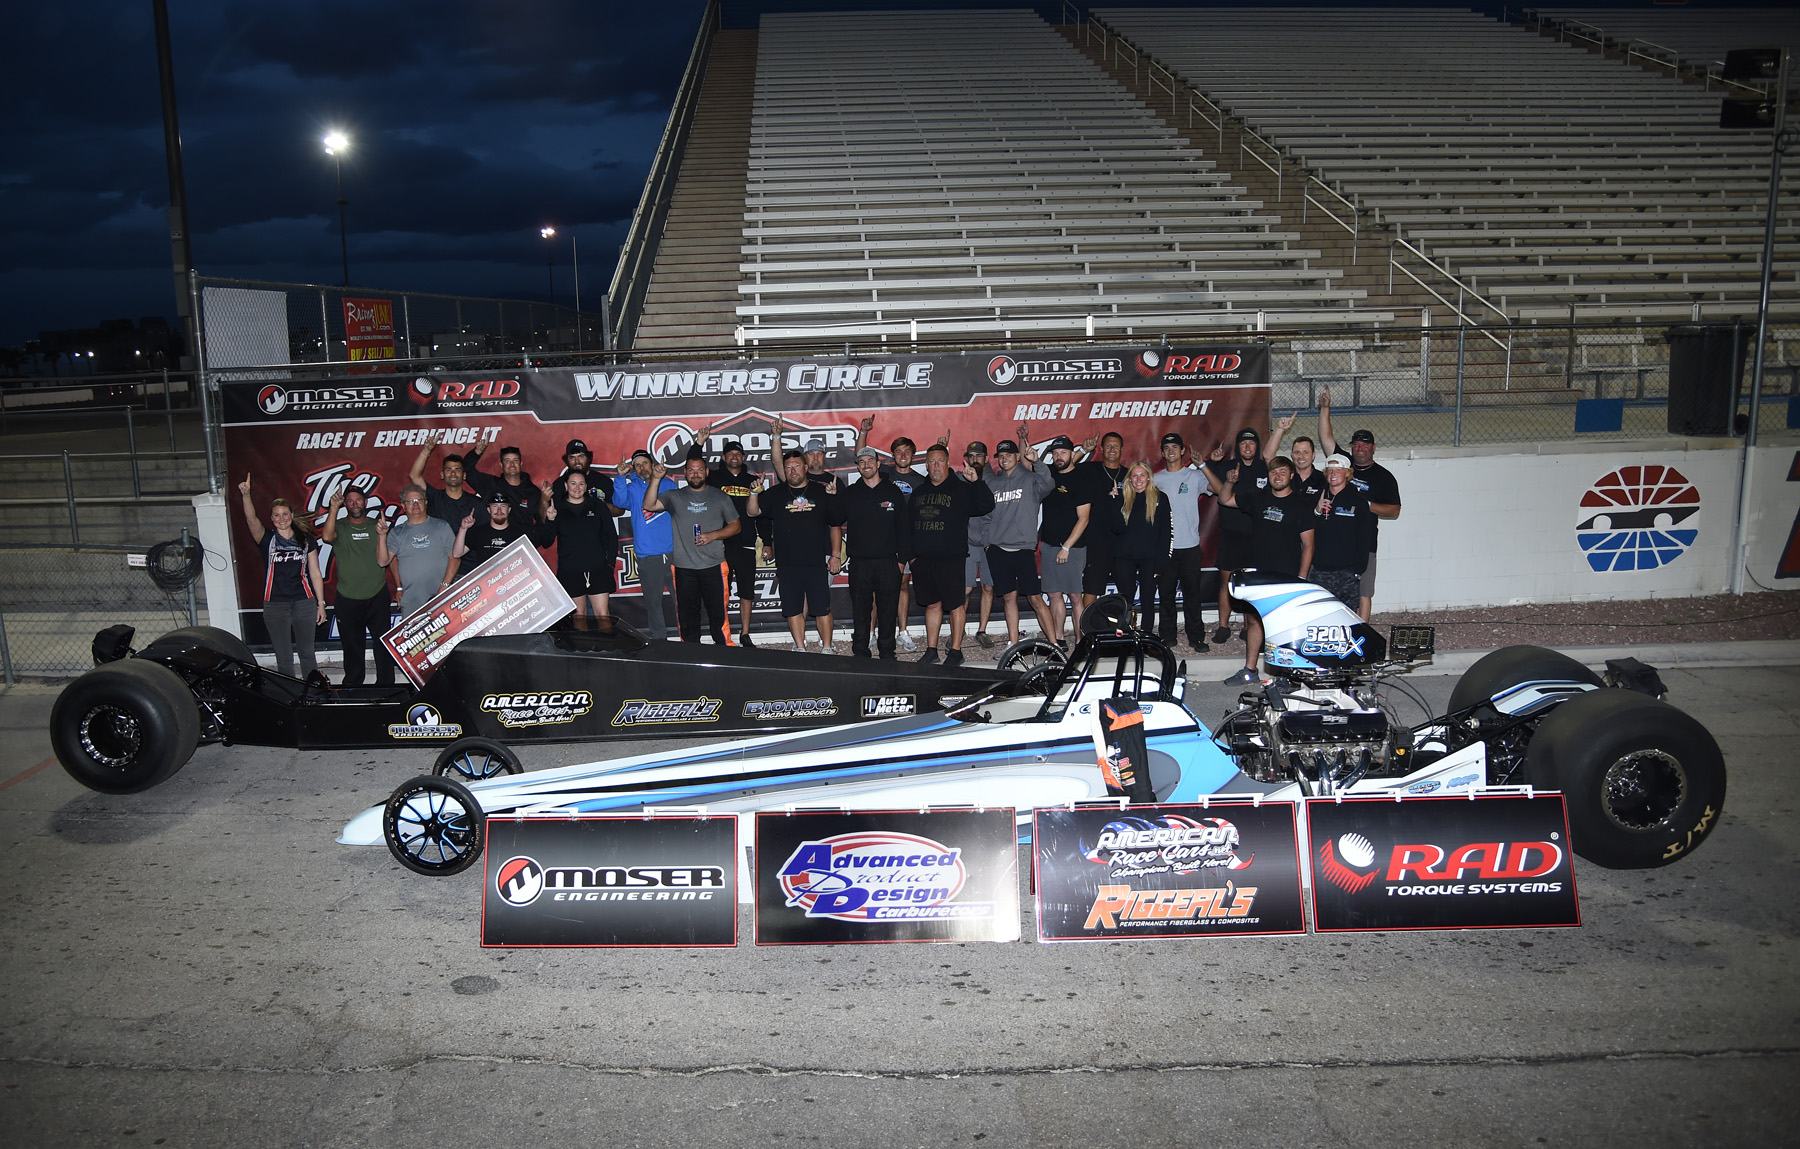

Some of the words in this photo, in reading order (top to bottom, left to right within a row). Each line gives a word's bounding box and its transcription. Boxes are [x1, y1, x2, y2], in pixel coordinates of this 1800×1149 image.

[368, 347, 379, 359] SELL
[1016, 358, 1122, 376] MOSER
[1163, 354, 1241, 373] RAD
[574, 368, 781, 401] WINNERS
[786, 362, 933, 393] CIRCLE
[1023, 373, 1115, 382] ENGINEERING
[286, 386, 394, 404] MOSER
[437, 380, 521, 401] RAD
[293, 401, 388, 411] ENGINEERING
[475, 399, 519, 407] SYSTEMS
[1013, 403, 1061, 421] RACE
[1061, 403, 1082, 419] IT
[1089, 400, 1191, 419] EXPERIENCE
[1191, 399, 1212, 416] IT
[296, 432, 345, 450] RACE
[345, 431, 367, 448] IT
[922, 521, 945, 531] YEARS
[497, 598, 539, 630] DRAGSTER
[395, 630, 427, 657] SPRING
[424, 612, 450, 635] FLING
[433, 640, 454, 660] CORY
[483, 693, 589, 708] AMERICAN
[744, 697, 833, 716] BIONDO
[876, 704, 914, 713] Meter
[879, 696, 908, 705] Auto
[614, 698, 720, 724] RIGGEAL'S
[757, 711, 790, 719] RACING
[792, 708, 837, 717] PRODUCTS
[390, 725, 461, 733] MOSER
[1097, 825, 1239, 849] AMERICAN
[781, 843, 958, 875] Advanced
[1107, 849, 1159, 868] Race
[1110, 866, 1170, 879] Champions
[1171, 859, 1201, 872] Built
[1201, 854, 1234, 868] Here!
[1385, 841, 1563, 881] RAD
[543, 865, 726, 890] MOSER
[790, 868, 941, 904] Product
[553, 891, 714, 902] ENGINEERING
[1385, 884, 1466, 896] TORQUE
[1467, 882, 1563, 895] SYSTEMS
[809, 886, 950, 914] Design
[1083, 879, 1258, 929] RIGGEAL'S
[874, 906, 992, 919] Carburetors
[1119, 919, 1168, 928] PERFORMANCE
[1169, 918, 1209, 926] FIBERGLASS
[1217, 917, 1260, 925] COMPOSITES
